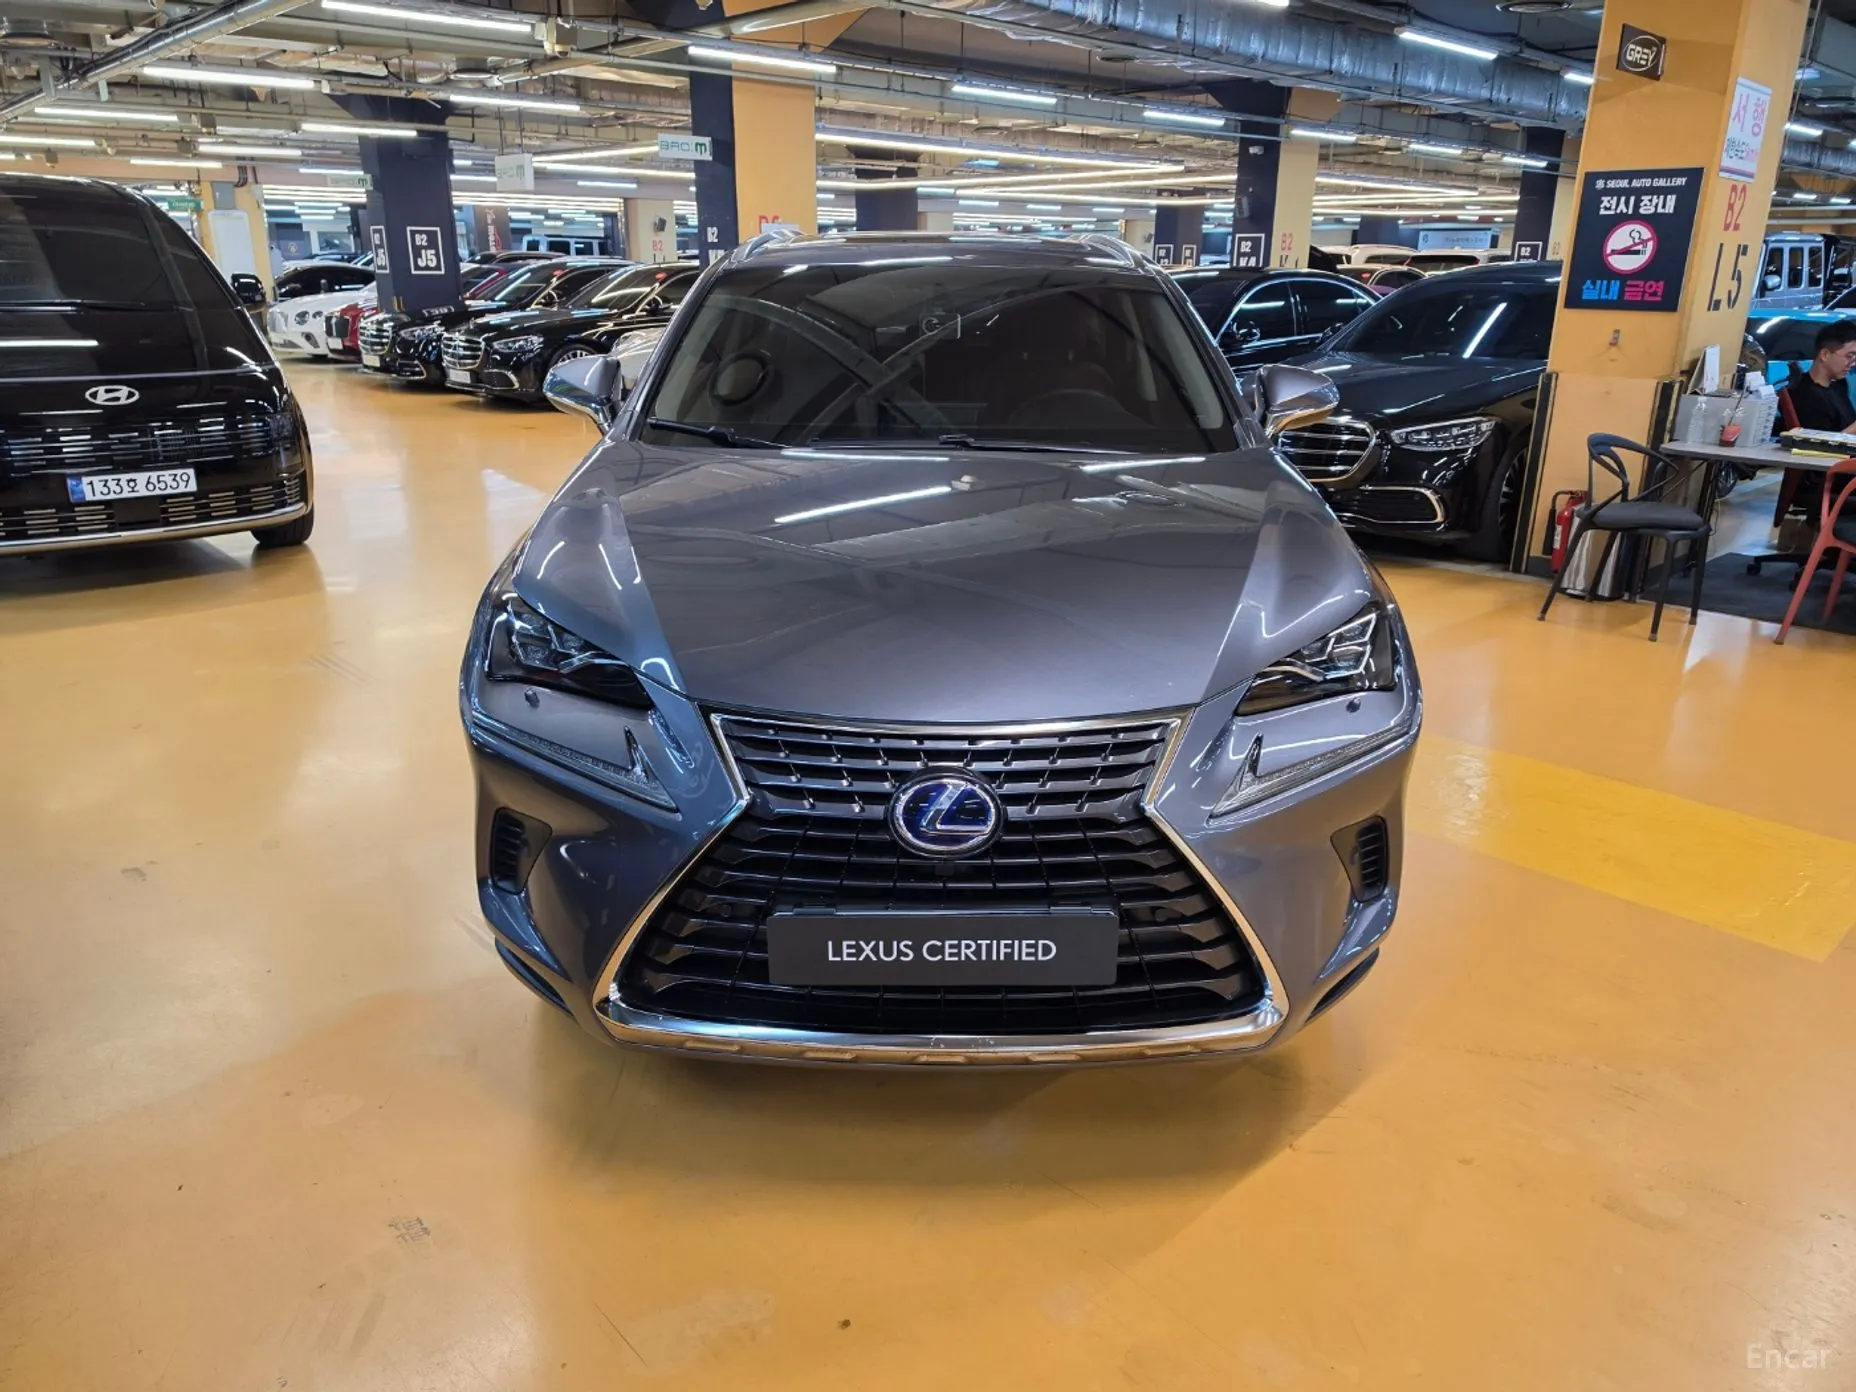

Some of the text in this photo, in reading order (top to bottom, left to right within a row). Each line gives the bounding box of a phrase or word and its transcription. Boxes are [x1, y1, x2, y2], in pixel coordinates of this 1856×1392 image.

[1626, 44, 1658, 67] GREY
[1606, 177, 1688, 189] SEOUL AUTO GALLERY
[1599, 194, 1677, 215] 전시 장내
[1723, 184, 1747, 231] B2
[415, 233, 428, 246] B2
[652, 239, 664, 251] B2
[707, 226, 719, 243] B2
[1240, 240, 1252, 252] B2
[417, 249, 438, 268] J5
[1707, 243, 1749, 313] L5
[1581, 280, 1665, 301] 실내 금연
[86, 472, 191, 497] 133호 6539
[828, 940, 1057, 961] LEXUS CERTIFIED
